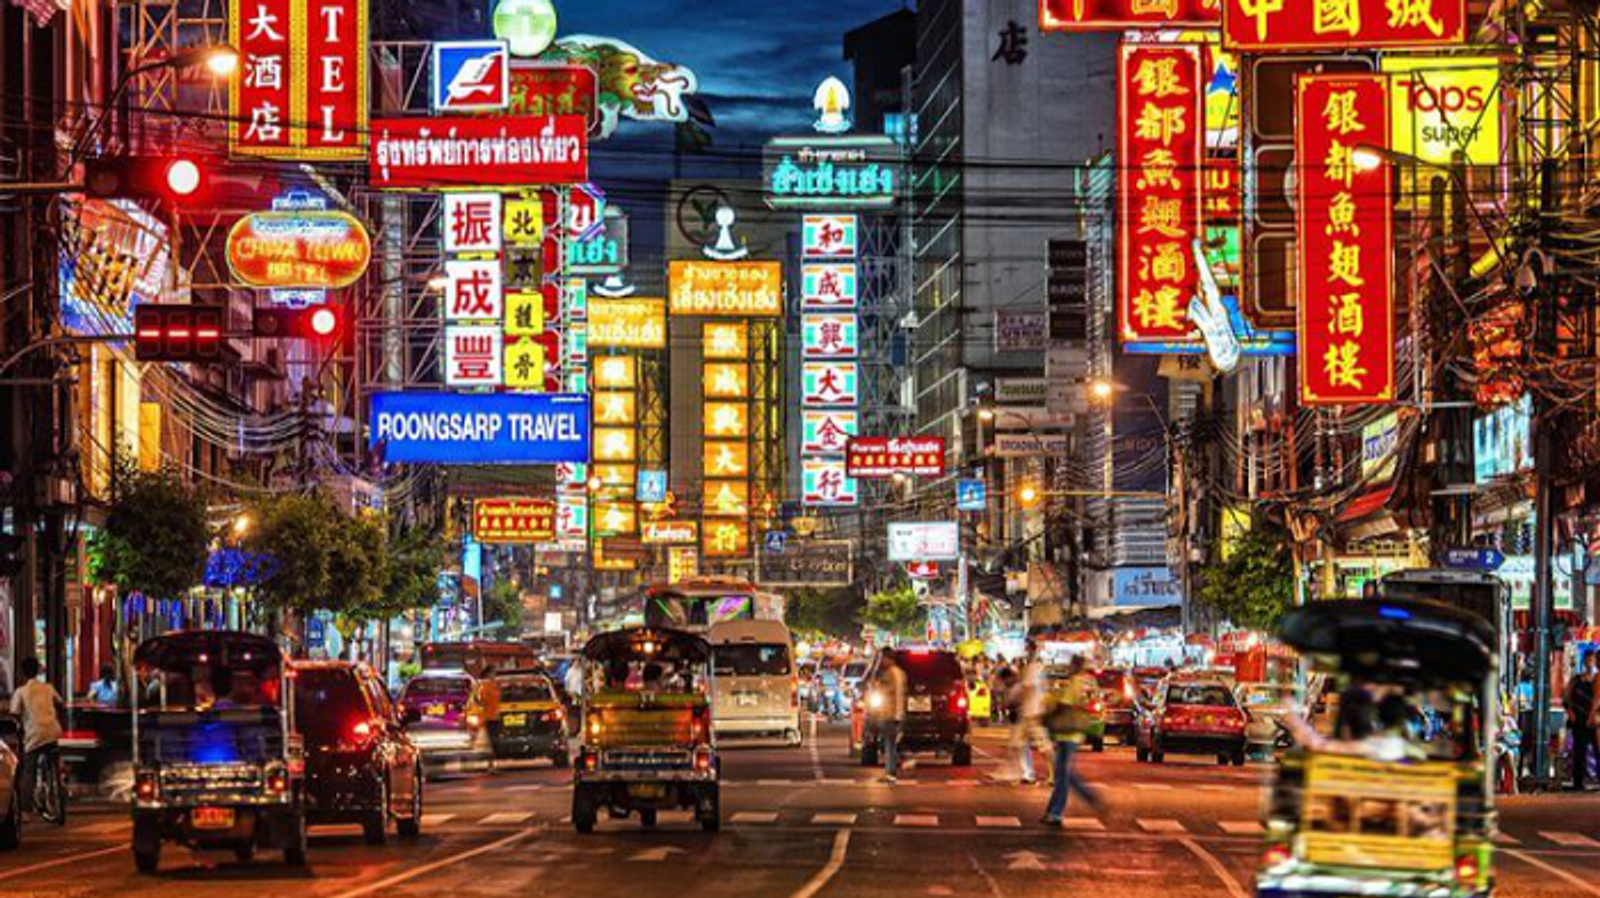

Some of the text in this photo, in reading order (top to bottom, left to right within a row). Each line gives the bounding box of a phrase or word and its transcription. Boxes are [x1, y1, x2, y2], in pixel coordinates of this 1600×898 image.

[992, 20, 1028, 65] 店
[244, 4, 285, 141] 大酒店
[1396, 80, 1484, 121] Tops
[1420, 125, 1483, 147] super
[236, 238, 361, 260] CHINA TOWN
[452, 201, 494, 380] 振成豐
[378, 412, 581, 440] ROONGSARP TRAVEL
